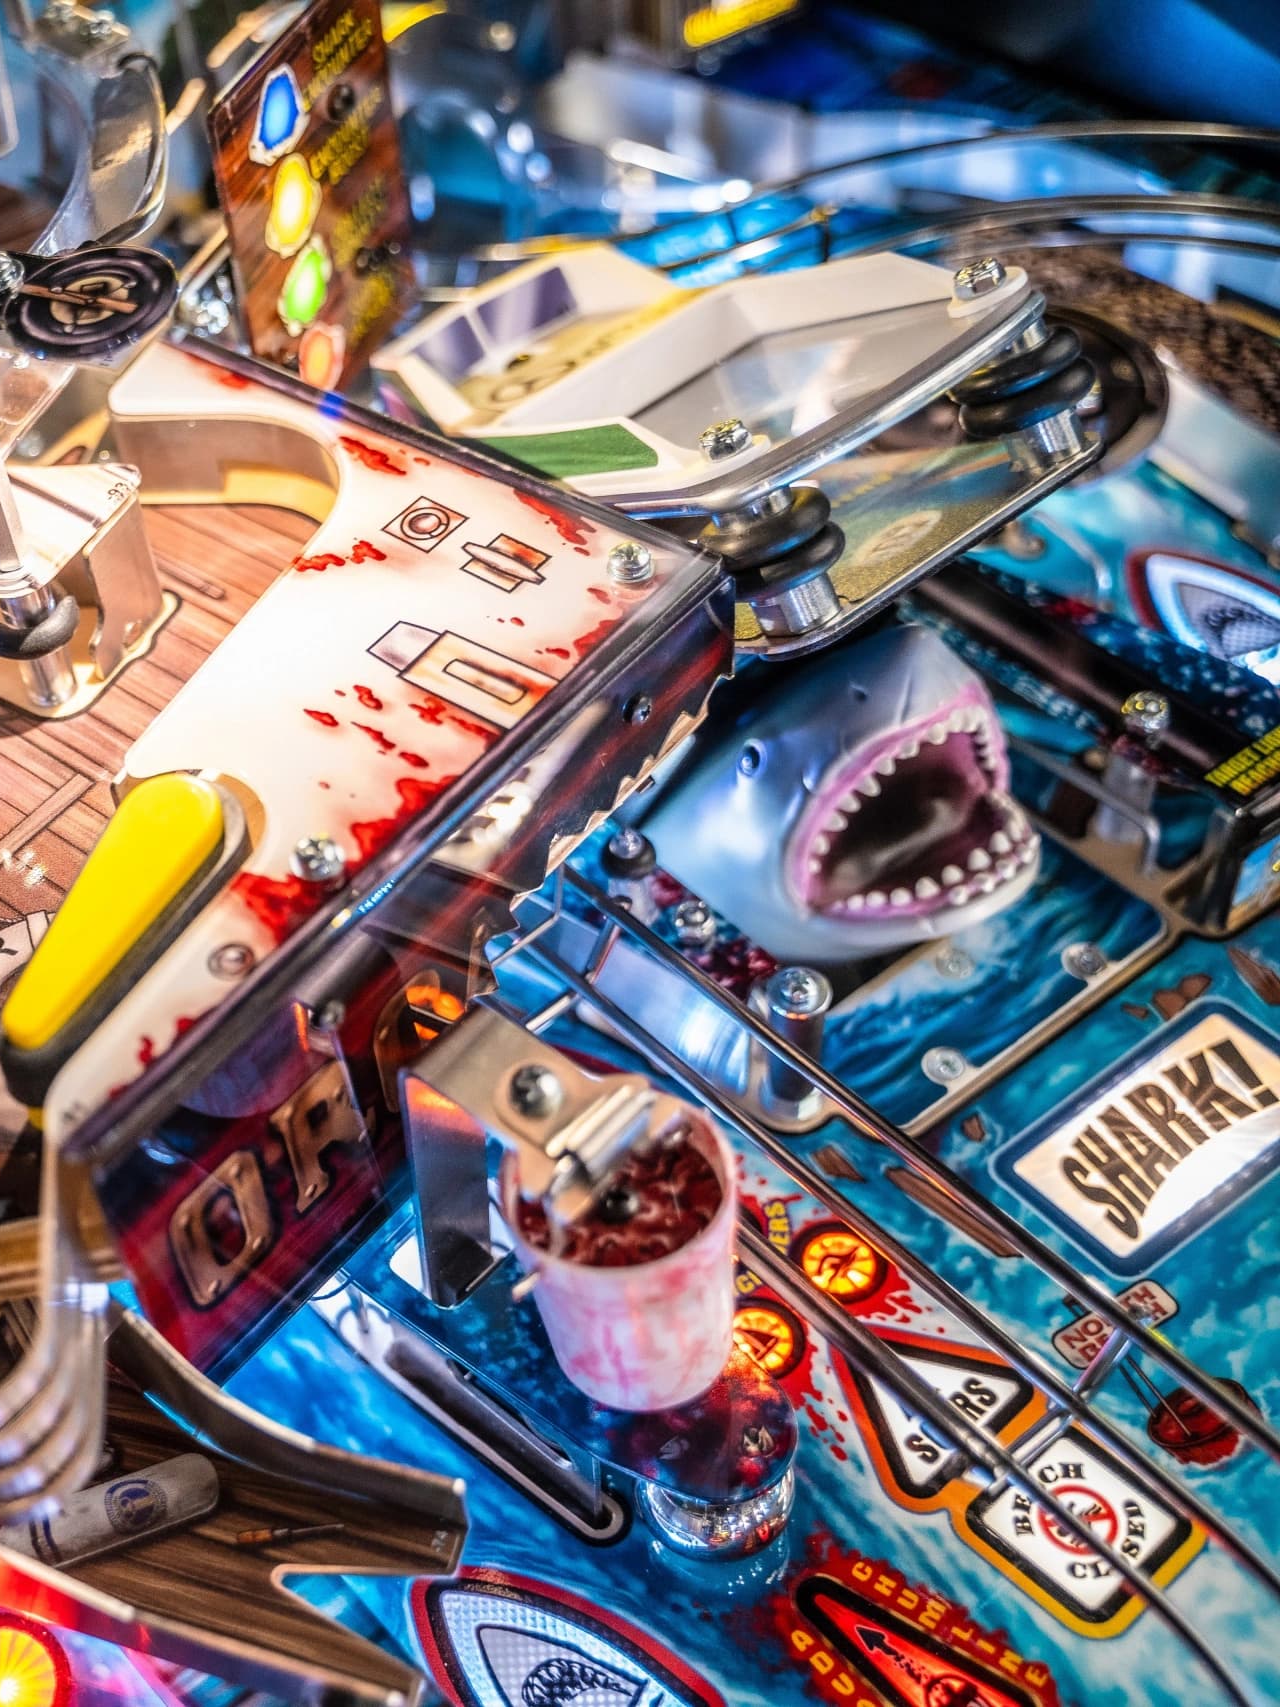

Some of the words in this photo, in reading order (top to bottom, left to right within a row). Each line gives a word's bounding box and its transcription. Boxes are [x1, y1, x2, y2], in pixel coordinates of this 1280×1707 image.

[1061, 1039, 1280, 1240] SHARK!
[1061, 1285, 1157, 1349] NOTH
[905, 1377, 998, 1464] SRS
[1013, 1462, 1085, 1536] BECH
[1067, 1499, 1146, 1579] CLSED
[851, 1561, 946, 1630] CHUM
[951, 1626, 1049, 1688] LINE
